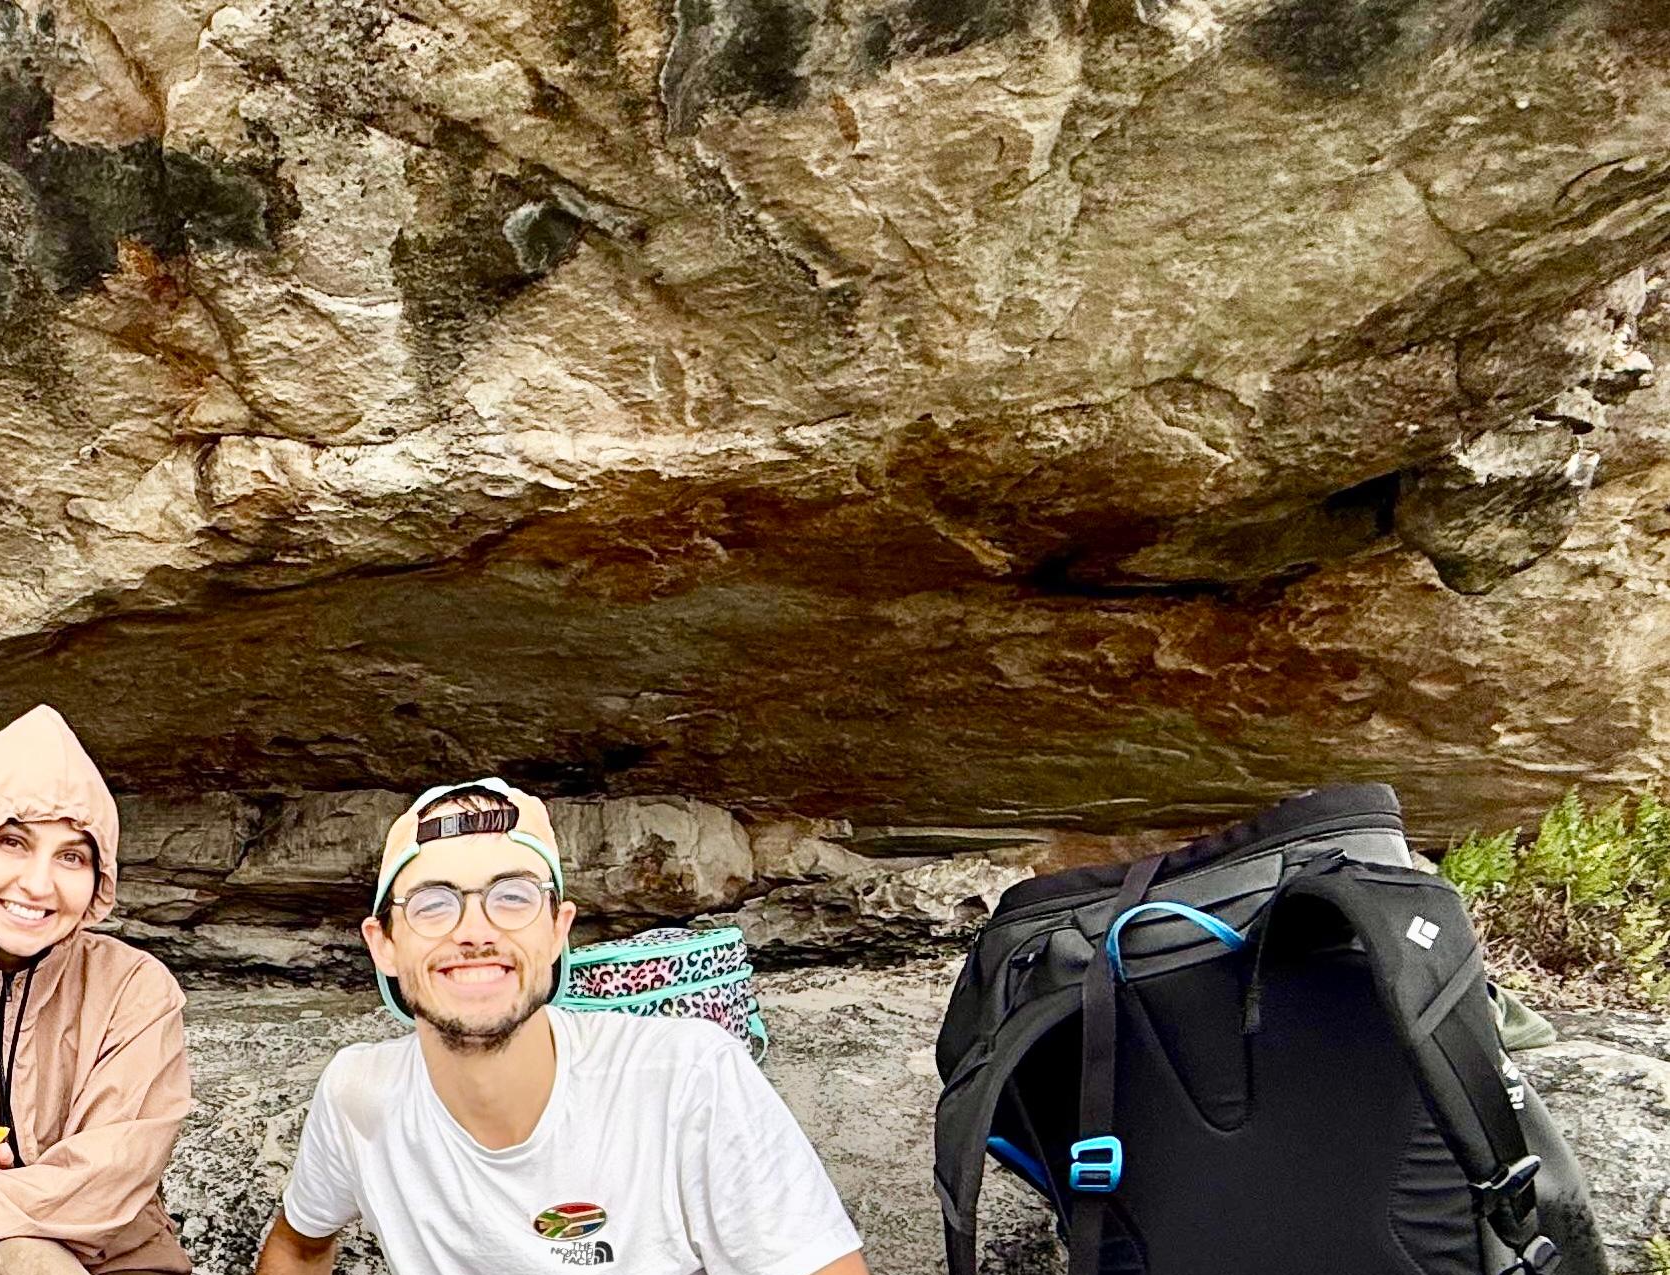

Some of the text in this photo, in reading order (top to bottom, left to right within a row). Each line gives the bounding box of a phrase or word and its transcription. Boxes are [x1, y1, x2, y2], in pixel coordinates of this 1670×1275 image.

[571, 1241, 593, 1250] THE
[550, 1247, 594, 1259] NORTH
[562, 1255, 593, 1266] FACE
